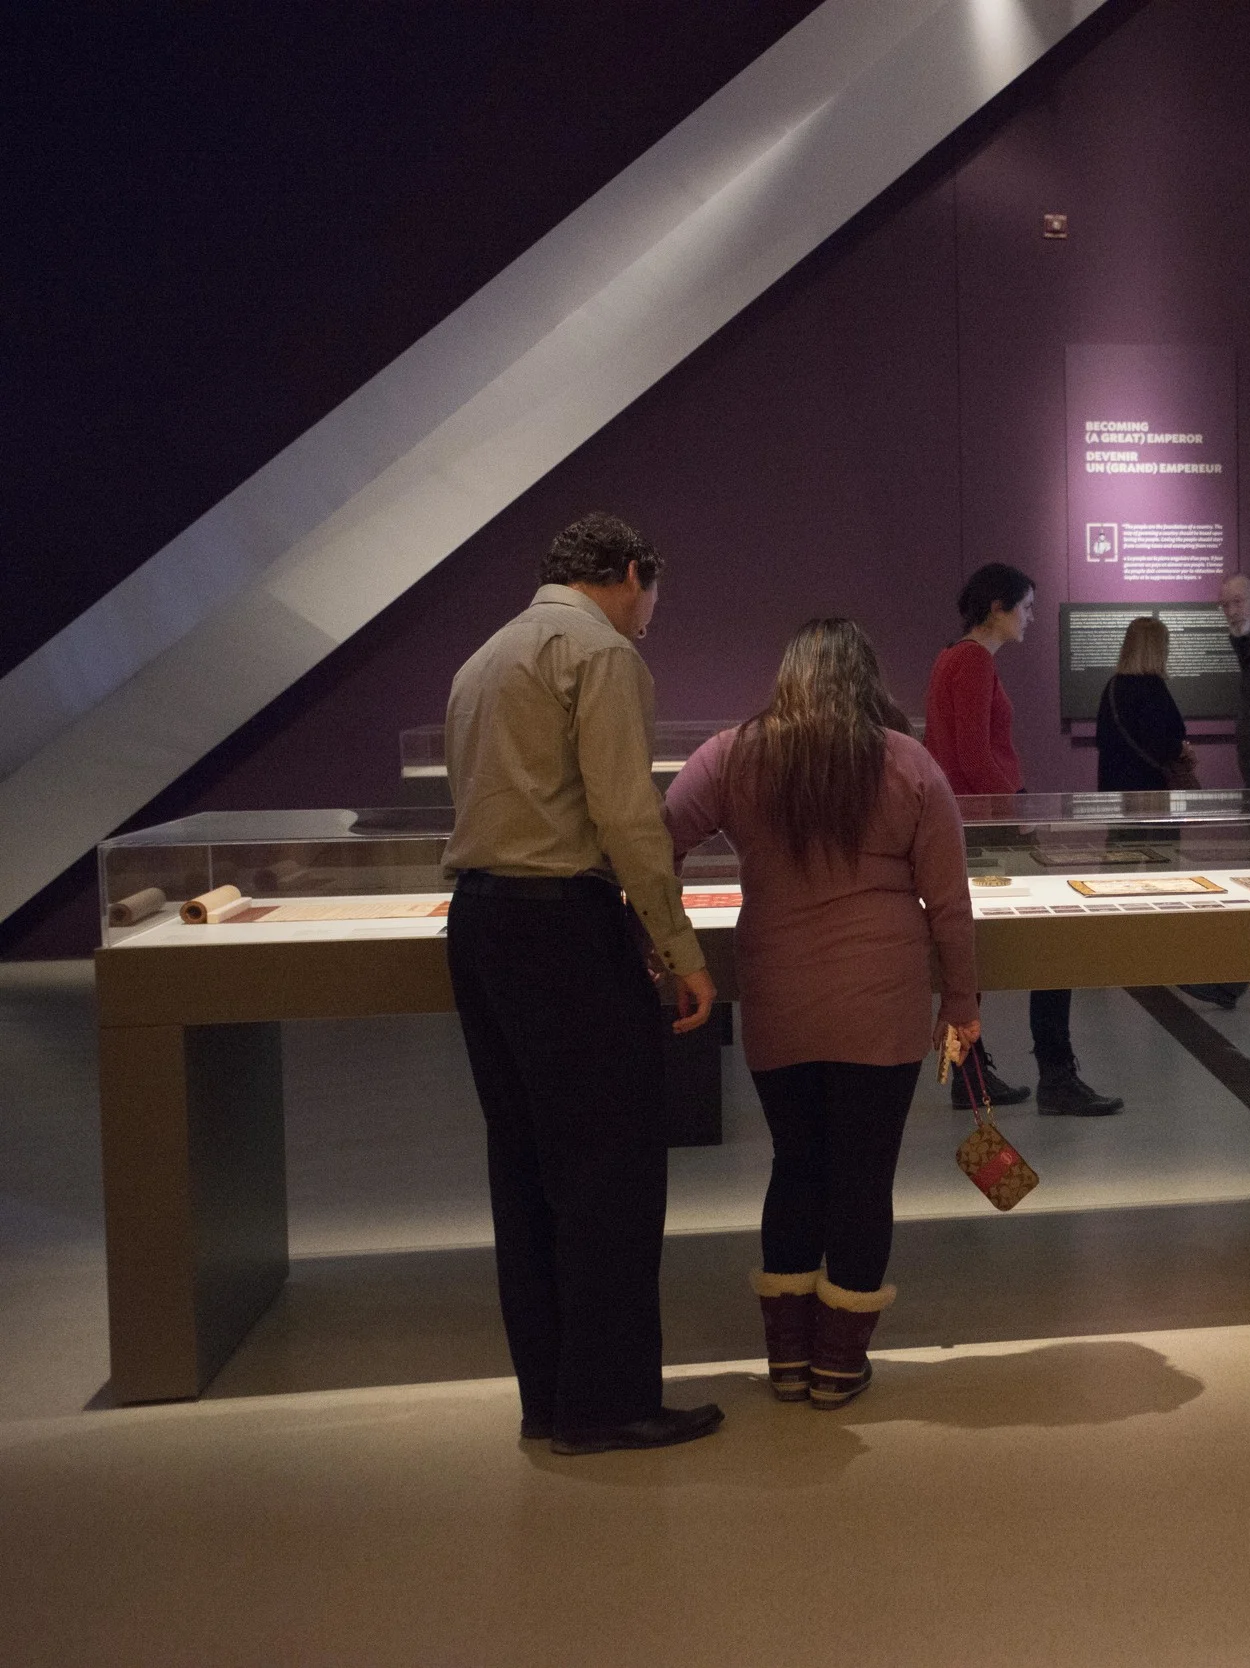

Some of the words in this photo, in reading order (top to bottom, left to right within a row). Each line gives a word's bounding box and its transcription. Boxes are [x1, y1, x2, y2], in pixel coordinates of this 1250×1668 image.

[1086, 421, 1149, 432] BECOMING
[1086, 433, 1098, 444] (A
[1101, 433, 1146, 445] GREAT)
[1147, 433, 1203, 444] EMPEROR
[1086, 452, 1138, 462] DEVENIR
[1086, 463, 1105, 473] UN
[1106, 463, 1158, 475] (GRAND)
[1159, 463, 1222, 474] EMPEREUR
